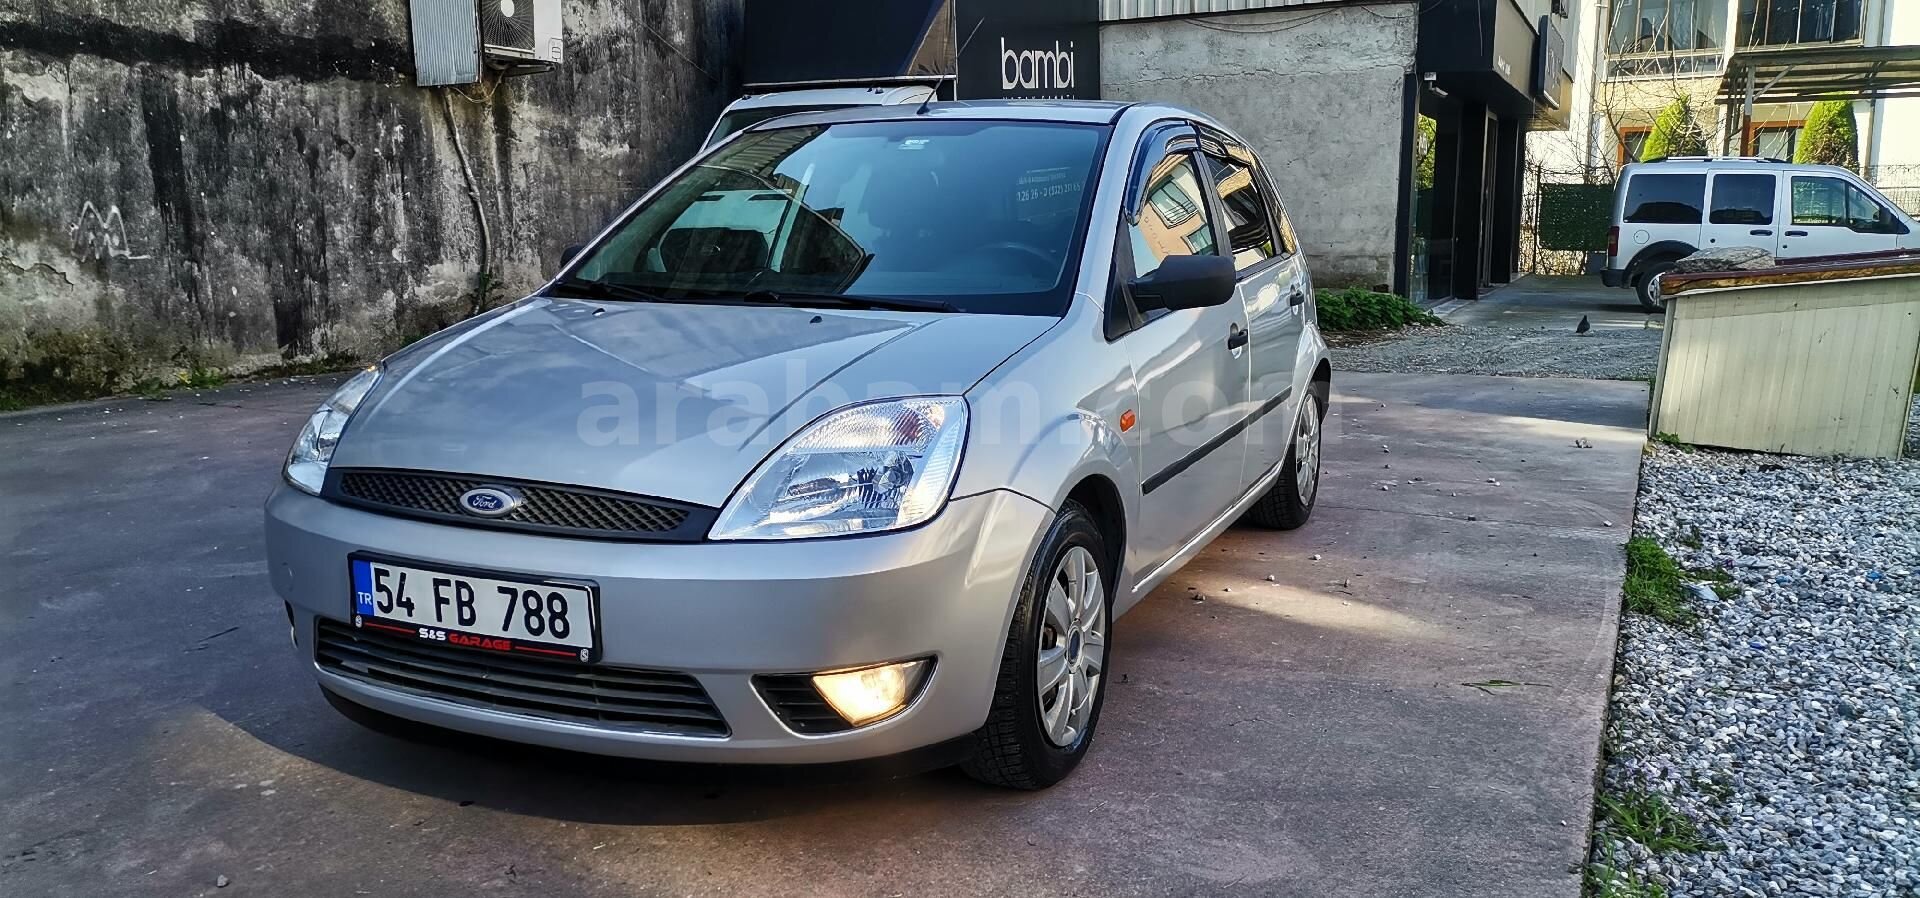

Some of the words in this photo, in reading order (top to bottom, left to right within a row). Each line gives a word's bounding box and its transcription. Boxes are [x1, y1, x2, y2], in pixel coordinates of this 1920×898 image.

[1001, 37, 1074, 89] bambi
[472, 495, 497, 509] Ford
[357, 591, 373, 606] TR
[374, 567, 415, 618] 54
[432, 578, 477, 627] FB
[497, 585, 570, 640] 788
[419, 628, 446, 642] S&S
[449, 633, 512, 651] GARAGE
